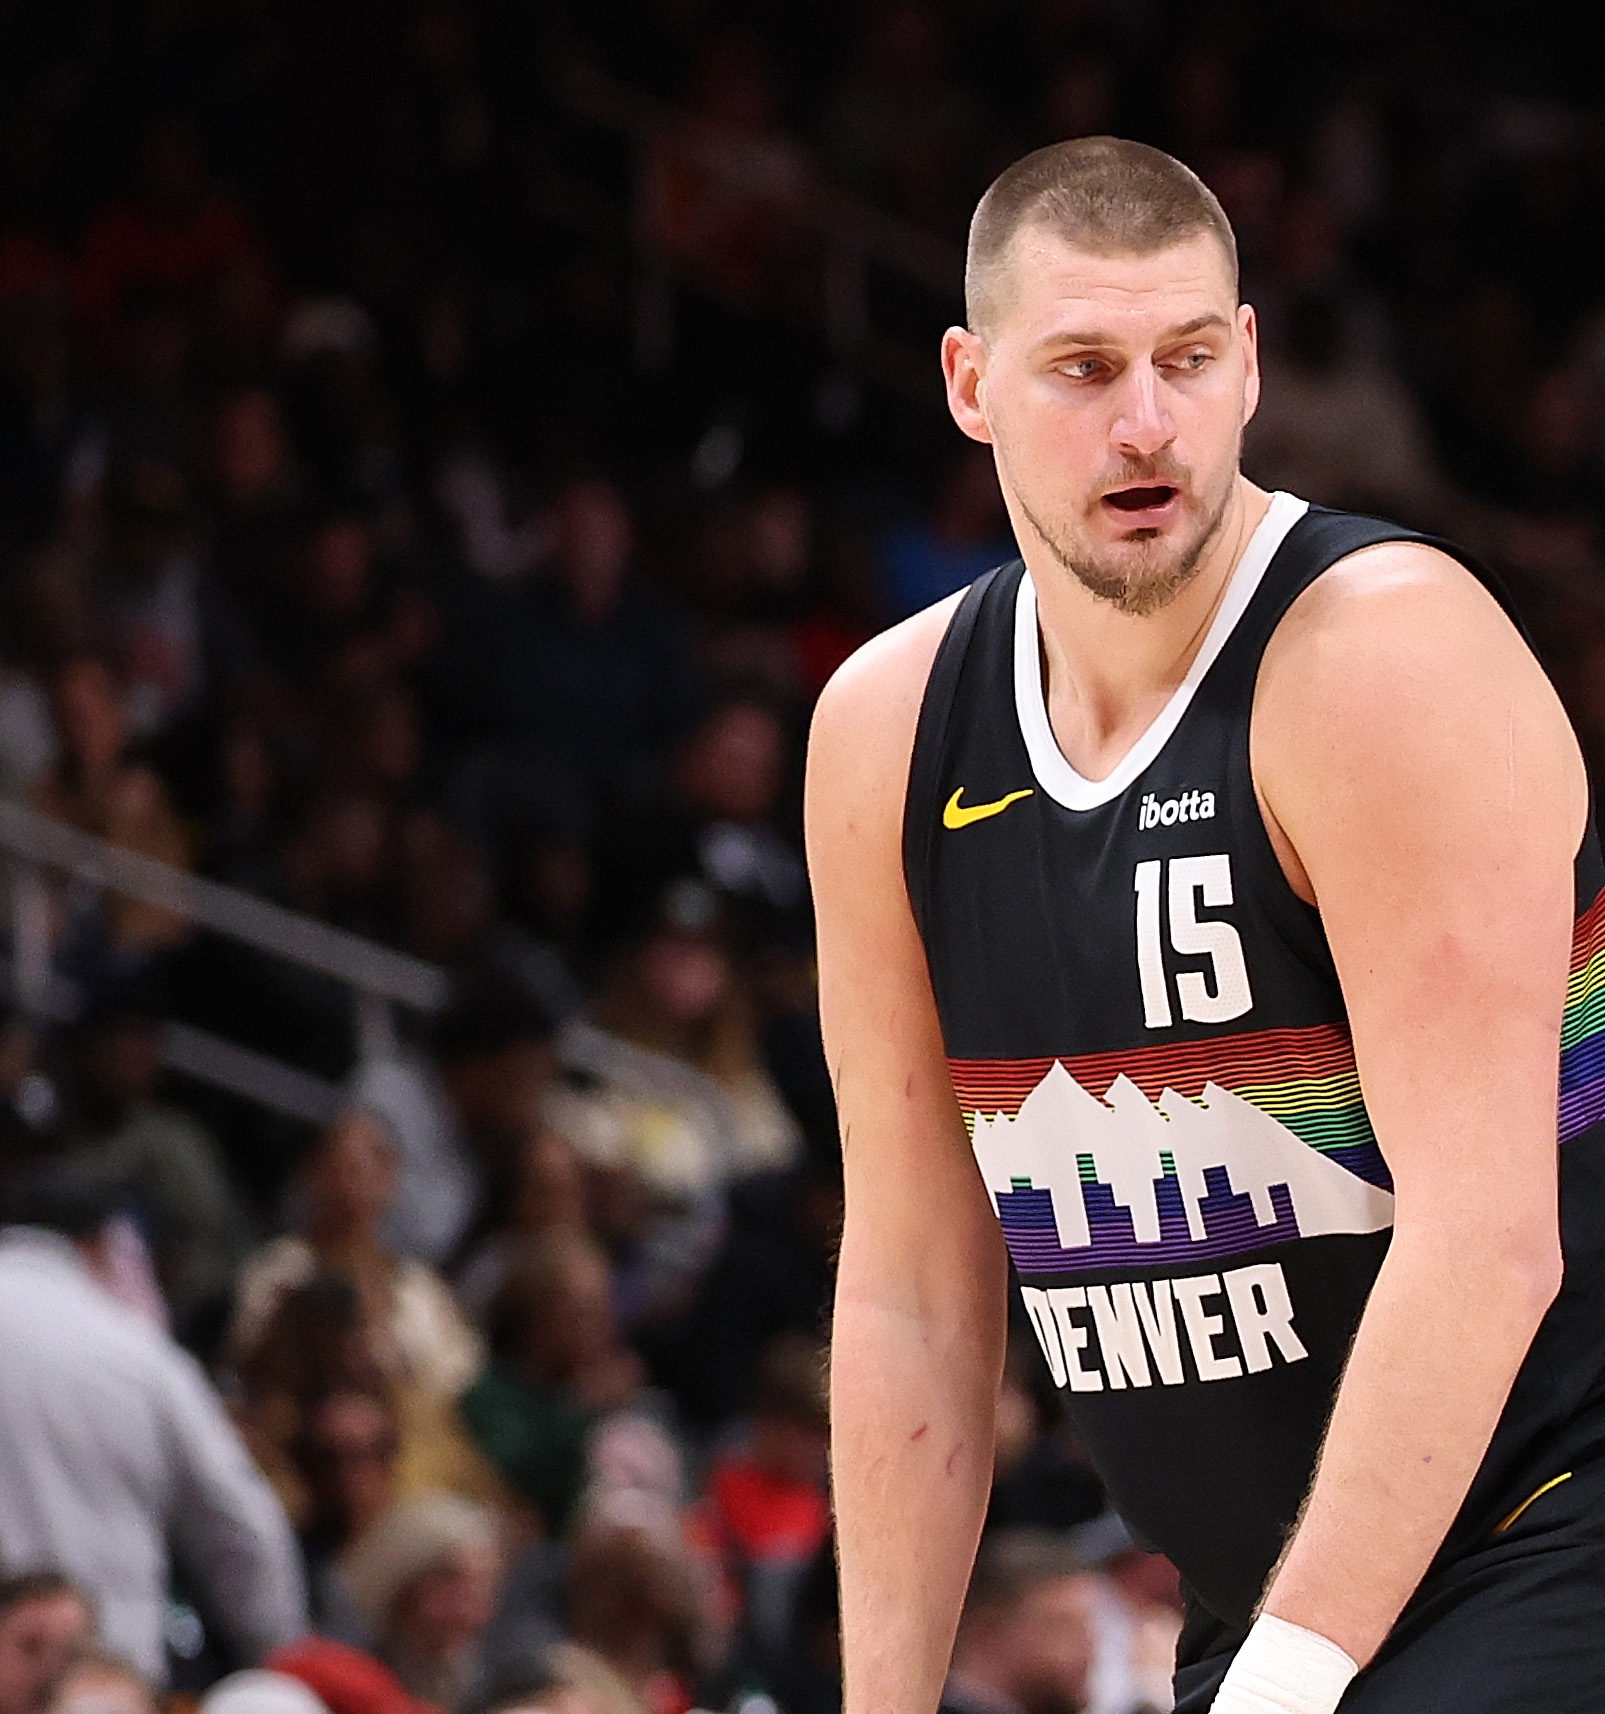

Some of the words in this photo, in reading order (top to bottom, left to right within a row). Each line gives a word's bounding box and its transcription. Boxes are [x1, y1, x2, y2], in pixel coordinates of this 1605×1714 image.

[1138, 789, 1215, 831] ibotta
[1134, 854, 1253, 1028] 15
[1021, 1262, 1308, 1393] DENVER
